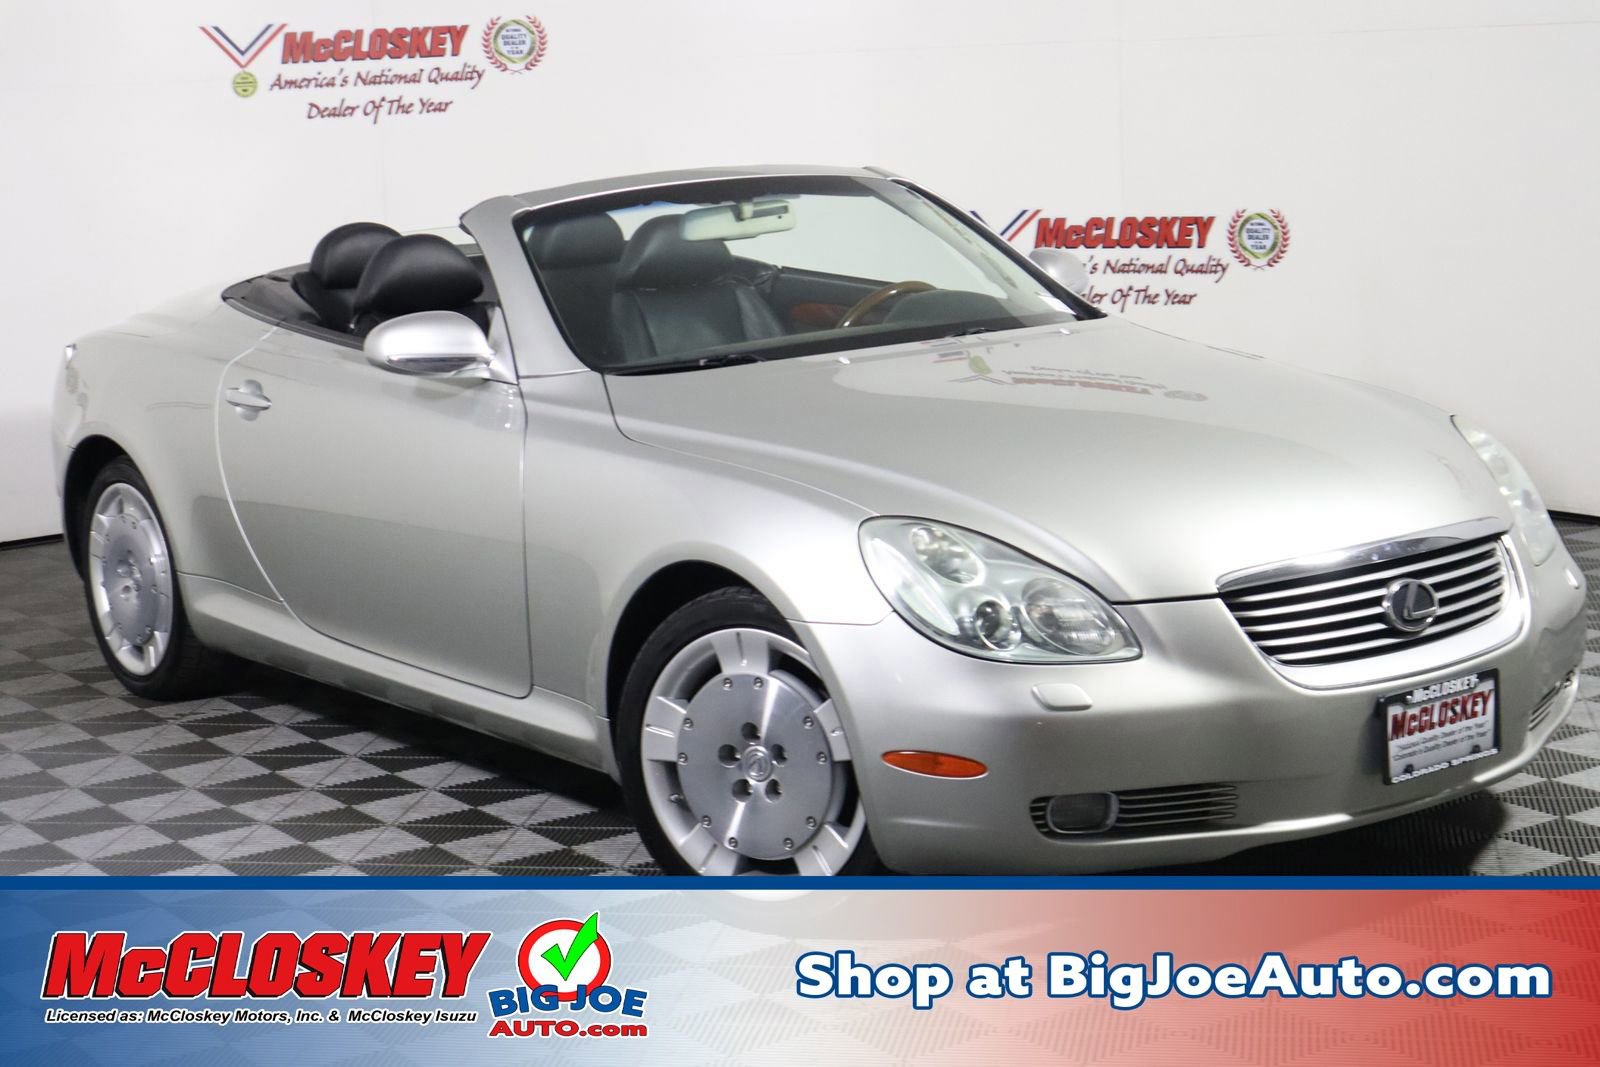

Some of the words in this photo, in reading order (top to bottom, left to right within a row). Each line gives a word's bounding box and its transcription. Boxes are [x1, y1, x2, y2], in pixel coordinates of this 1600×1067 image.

[281, 24, 469, 64] McCLOSKEY
[269, 68, 348, 91] America's
[354, 68, 422, 87] National
[427, 62, 485, 90] Quality
[307, 98, 359, 119] Dealer
[363, 96, 386, 124] Of
[387, 96, 414, 116] The
[418, 98, 453, 114] Year
[1034, 215, 1216, 250] McCLOSKEY
[1102, 255, 1172, 275] National
[1173, 255, 1230, 283] Quality
[1111, 285, 1134, 313] Of
[1134, 285, 1160, 304] The
[1164, 288, 1197, 306] Year
